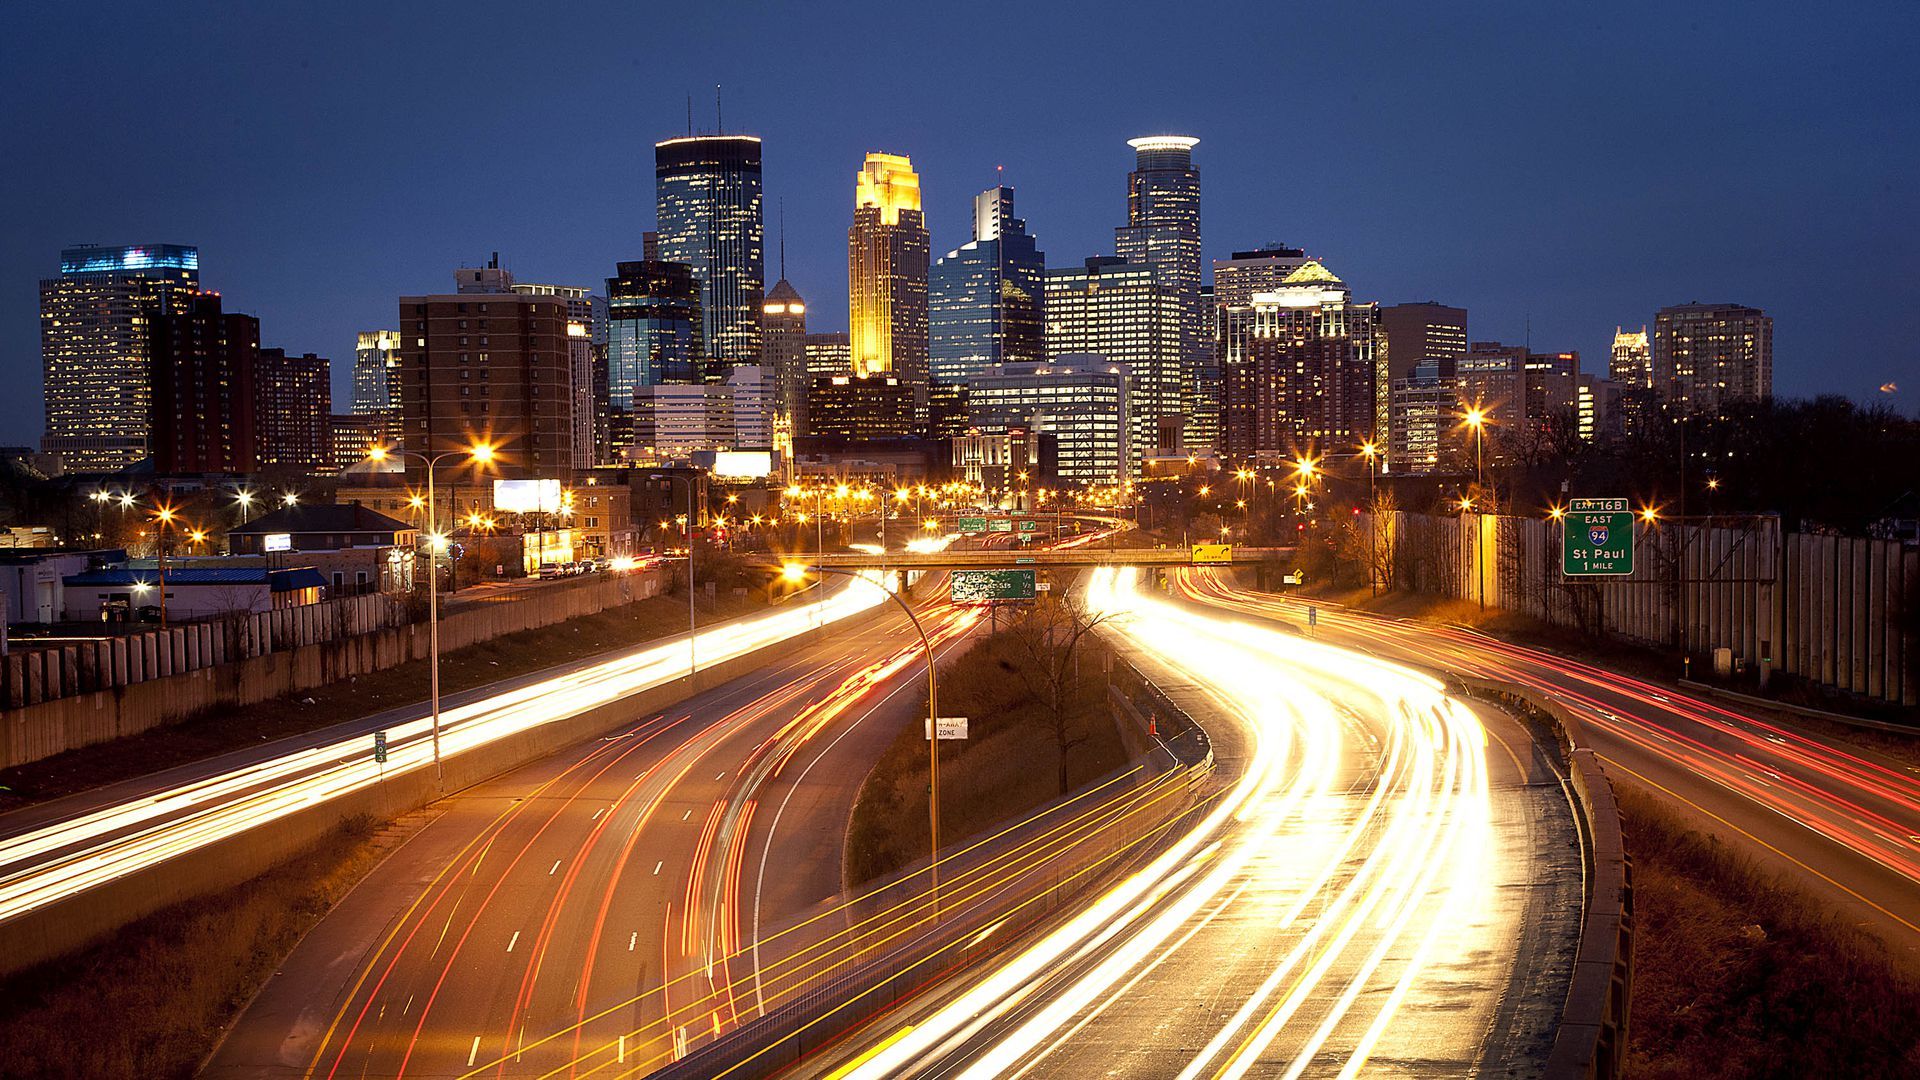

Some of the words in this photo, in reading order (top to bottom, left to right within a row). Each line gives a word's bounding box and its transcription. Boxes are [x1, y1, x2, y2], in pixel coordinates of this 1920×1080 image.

[1600, 501, 1622, 510] 16B
[1591, 532, 1605, 540] 94
[1573, 549, 1587, 558] St
[1594, 549, 1624, 558] Paul
[1584, 562, 1588, 571] 1
